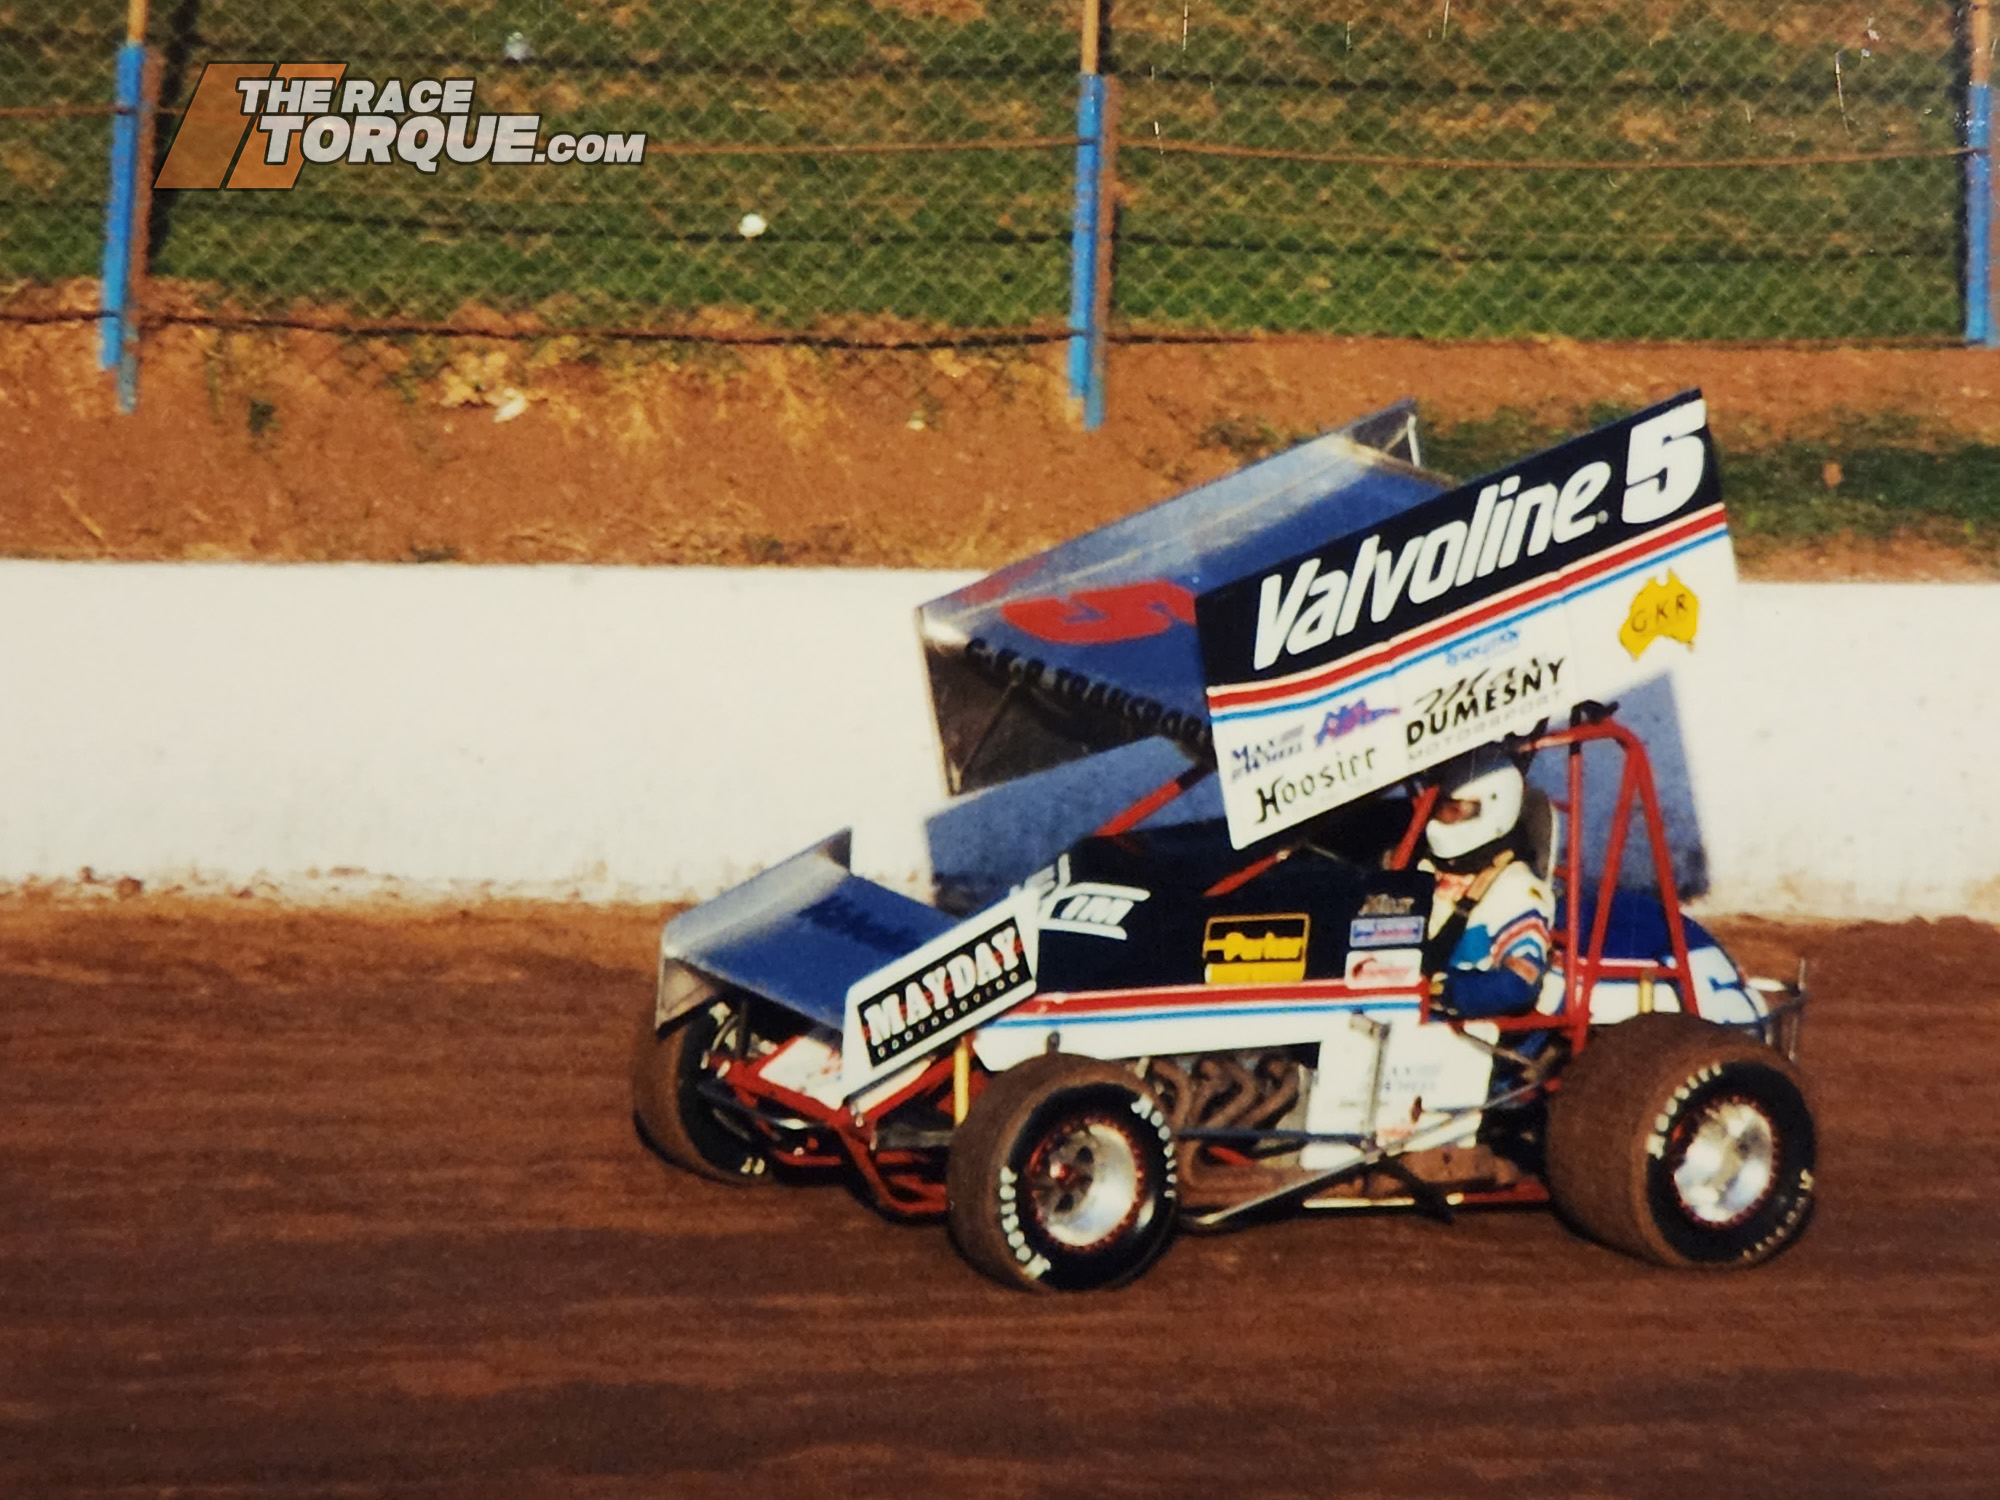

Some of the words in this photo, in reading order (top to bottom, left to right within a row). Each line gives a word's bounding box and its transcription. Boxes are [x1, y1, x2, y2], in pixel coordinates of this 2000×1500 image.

[1253, 460, 1612, 671] Valvoline
[1621, 398, 1707, 525] 5
[1405, 656, 1566, 746] DUMESNY
[863, 926, 1021, 1047] MAYDAY
